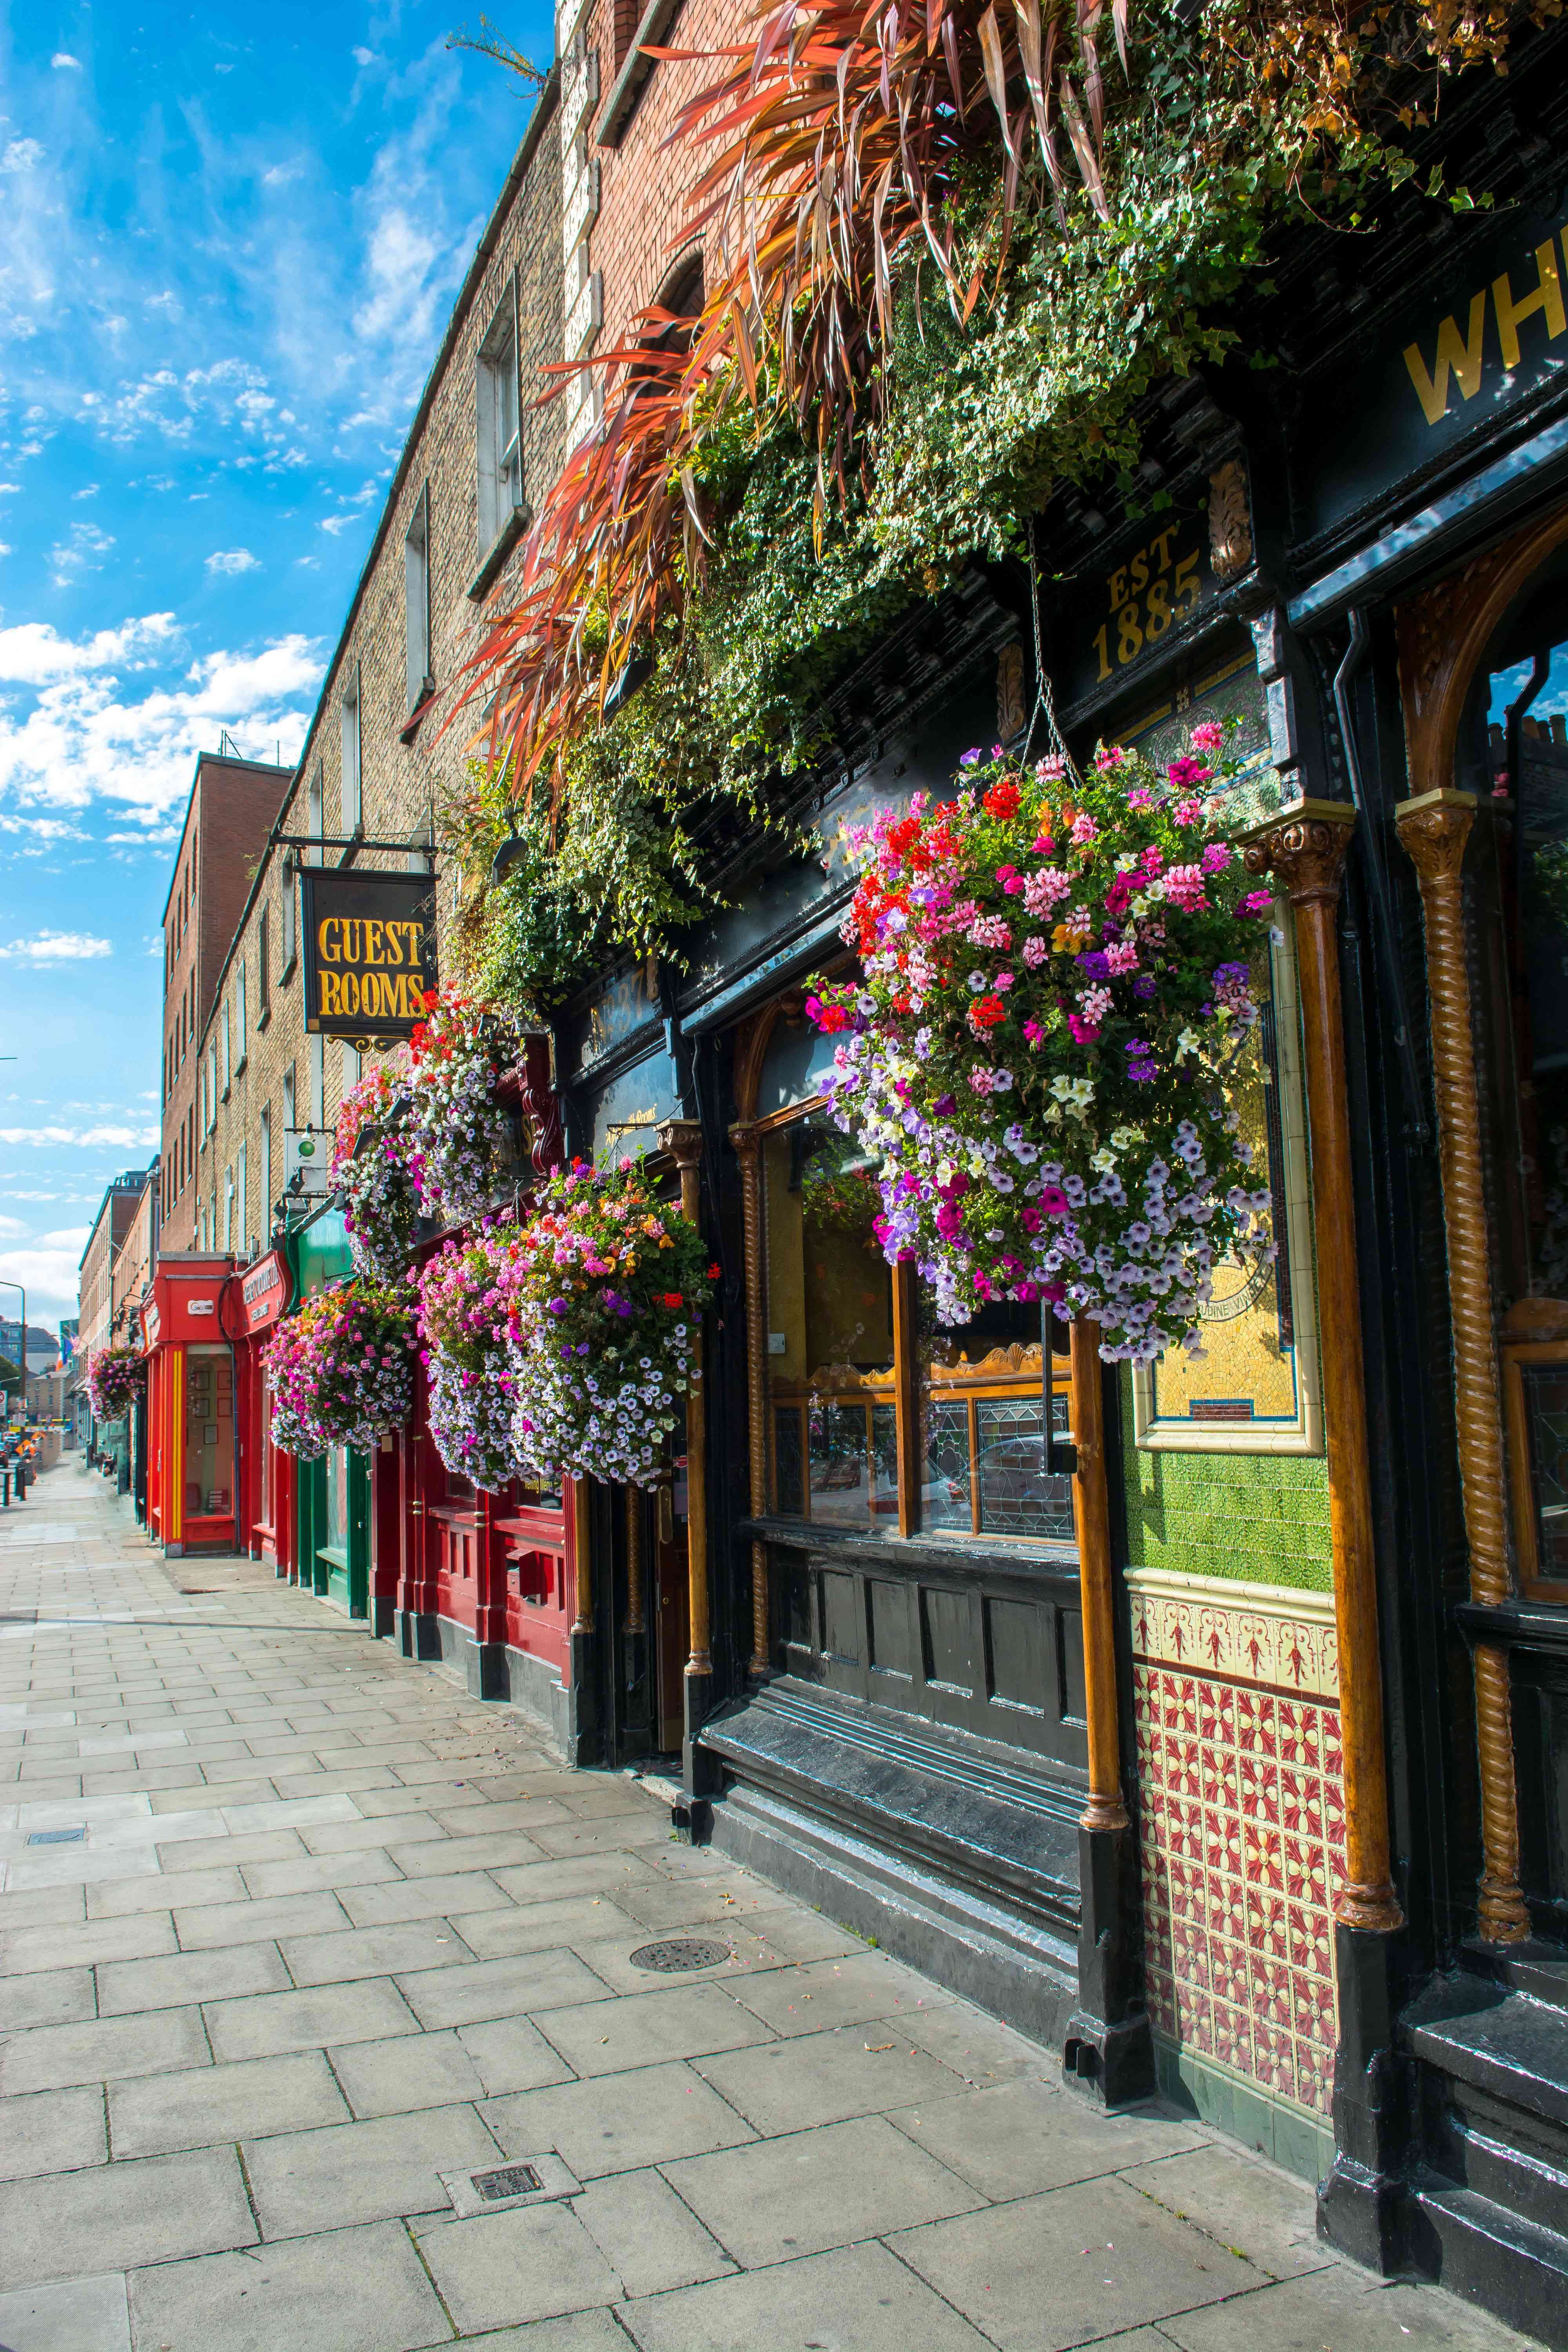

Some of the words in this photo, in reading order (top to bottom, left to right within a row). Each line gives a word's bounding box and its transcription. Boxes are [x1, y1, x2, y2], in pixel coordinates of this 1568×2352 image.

[1107, 525, 1179, 615] EST
[1092, 548, 1202, 683] 1885
[318, 918, 424, 966] GUEST
[318, 971, 426, 1018] ROOMS
